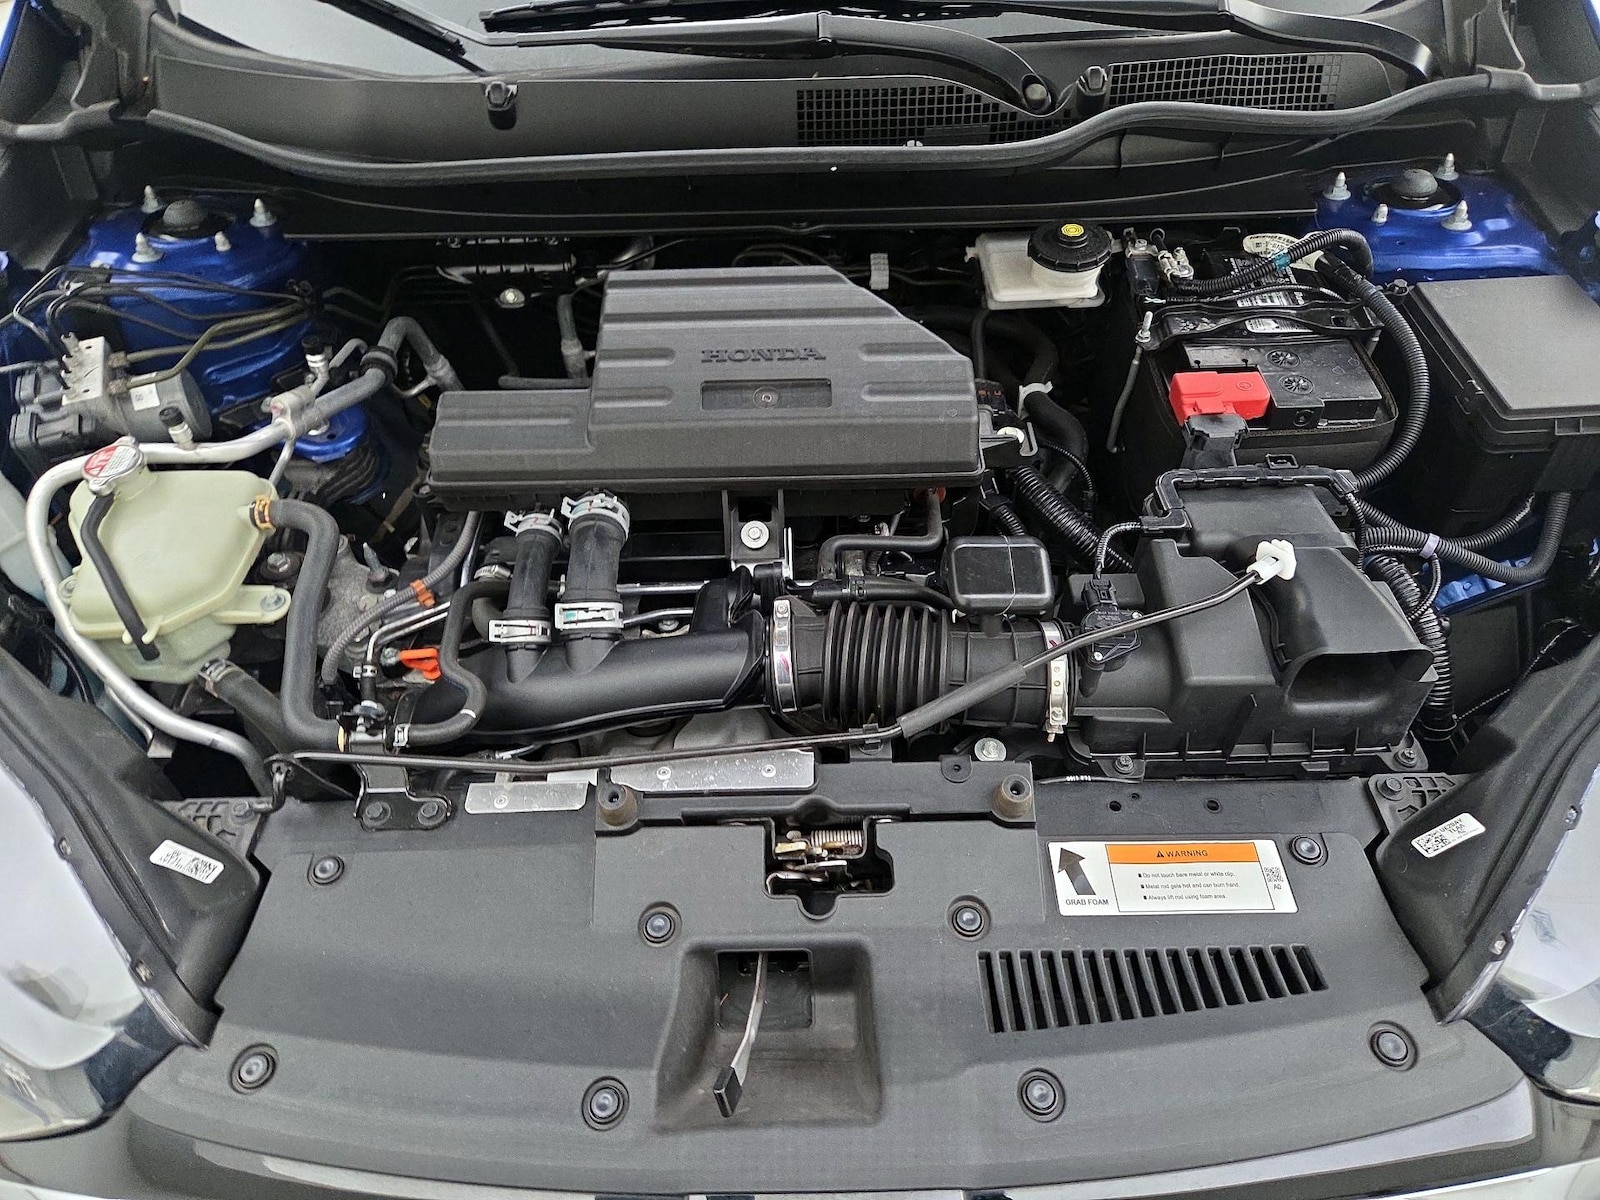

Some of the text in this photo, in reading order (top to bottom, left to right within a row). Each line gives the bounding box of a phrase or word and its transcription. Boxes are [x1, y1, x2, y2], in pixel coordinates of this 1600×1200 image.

[701, 348, 826, 362] HONDA
[1166, 849, 1208, 858] WARNING
[1065, 898, 1109, 906] GRAB FOAM
